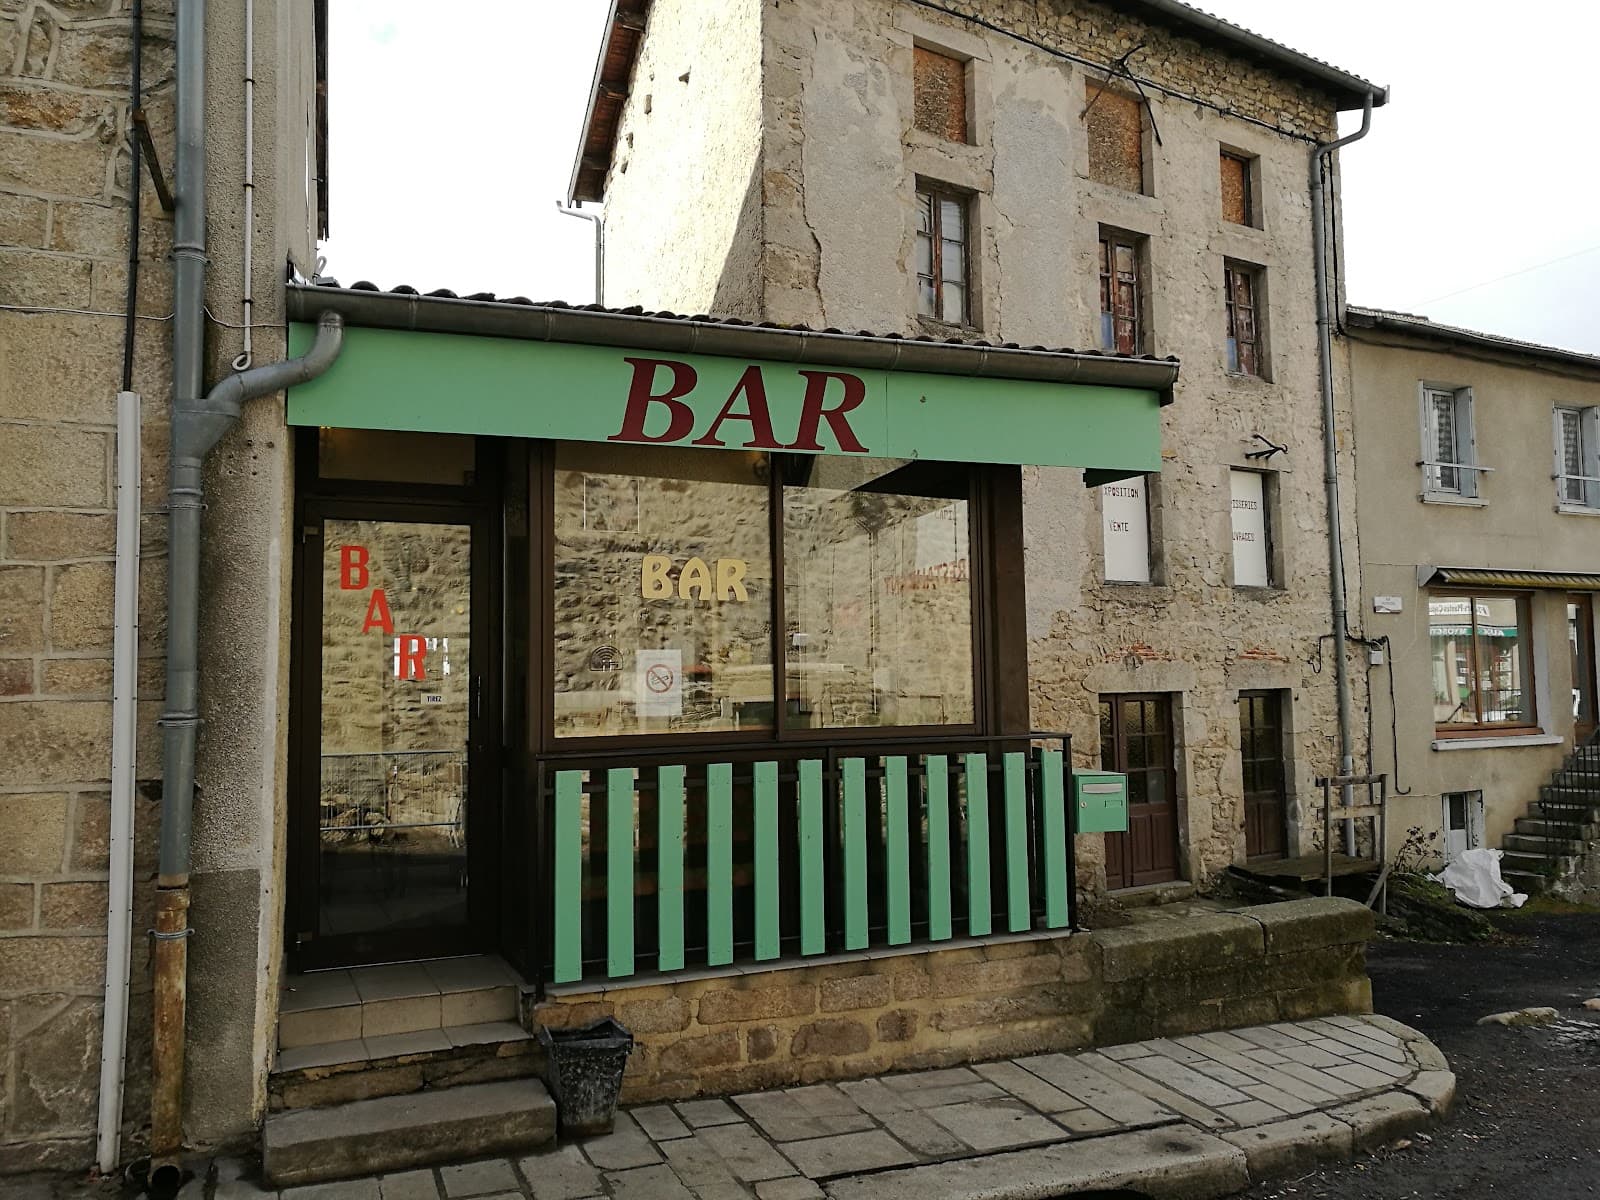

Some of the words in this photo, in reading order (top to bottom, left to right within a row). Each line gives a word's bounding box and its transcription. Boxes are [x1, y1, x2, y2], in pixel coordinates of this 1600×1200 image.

[607, 357, 869, 453] BAR
[1108, 520, 1128, 532] VENTE
[641, 555, 748, 602] BAR
[340, 545, 429, 681] BAR
[426, 695, 442, 703] TIREZ
